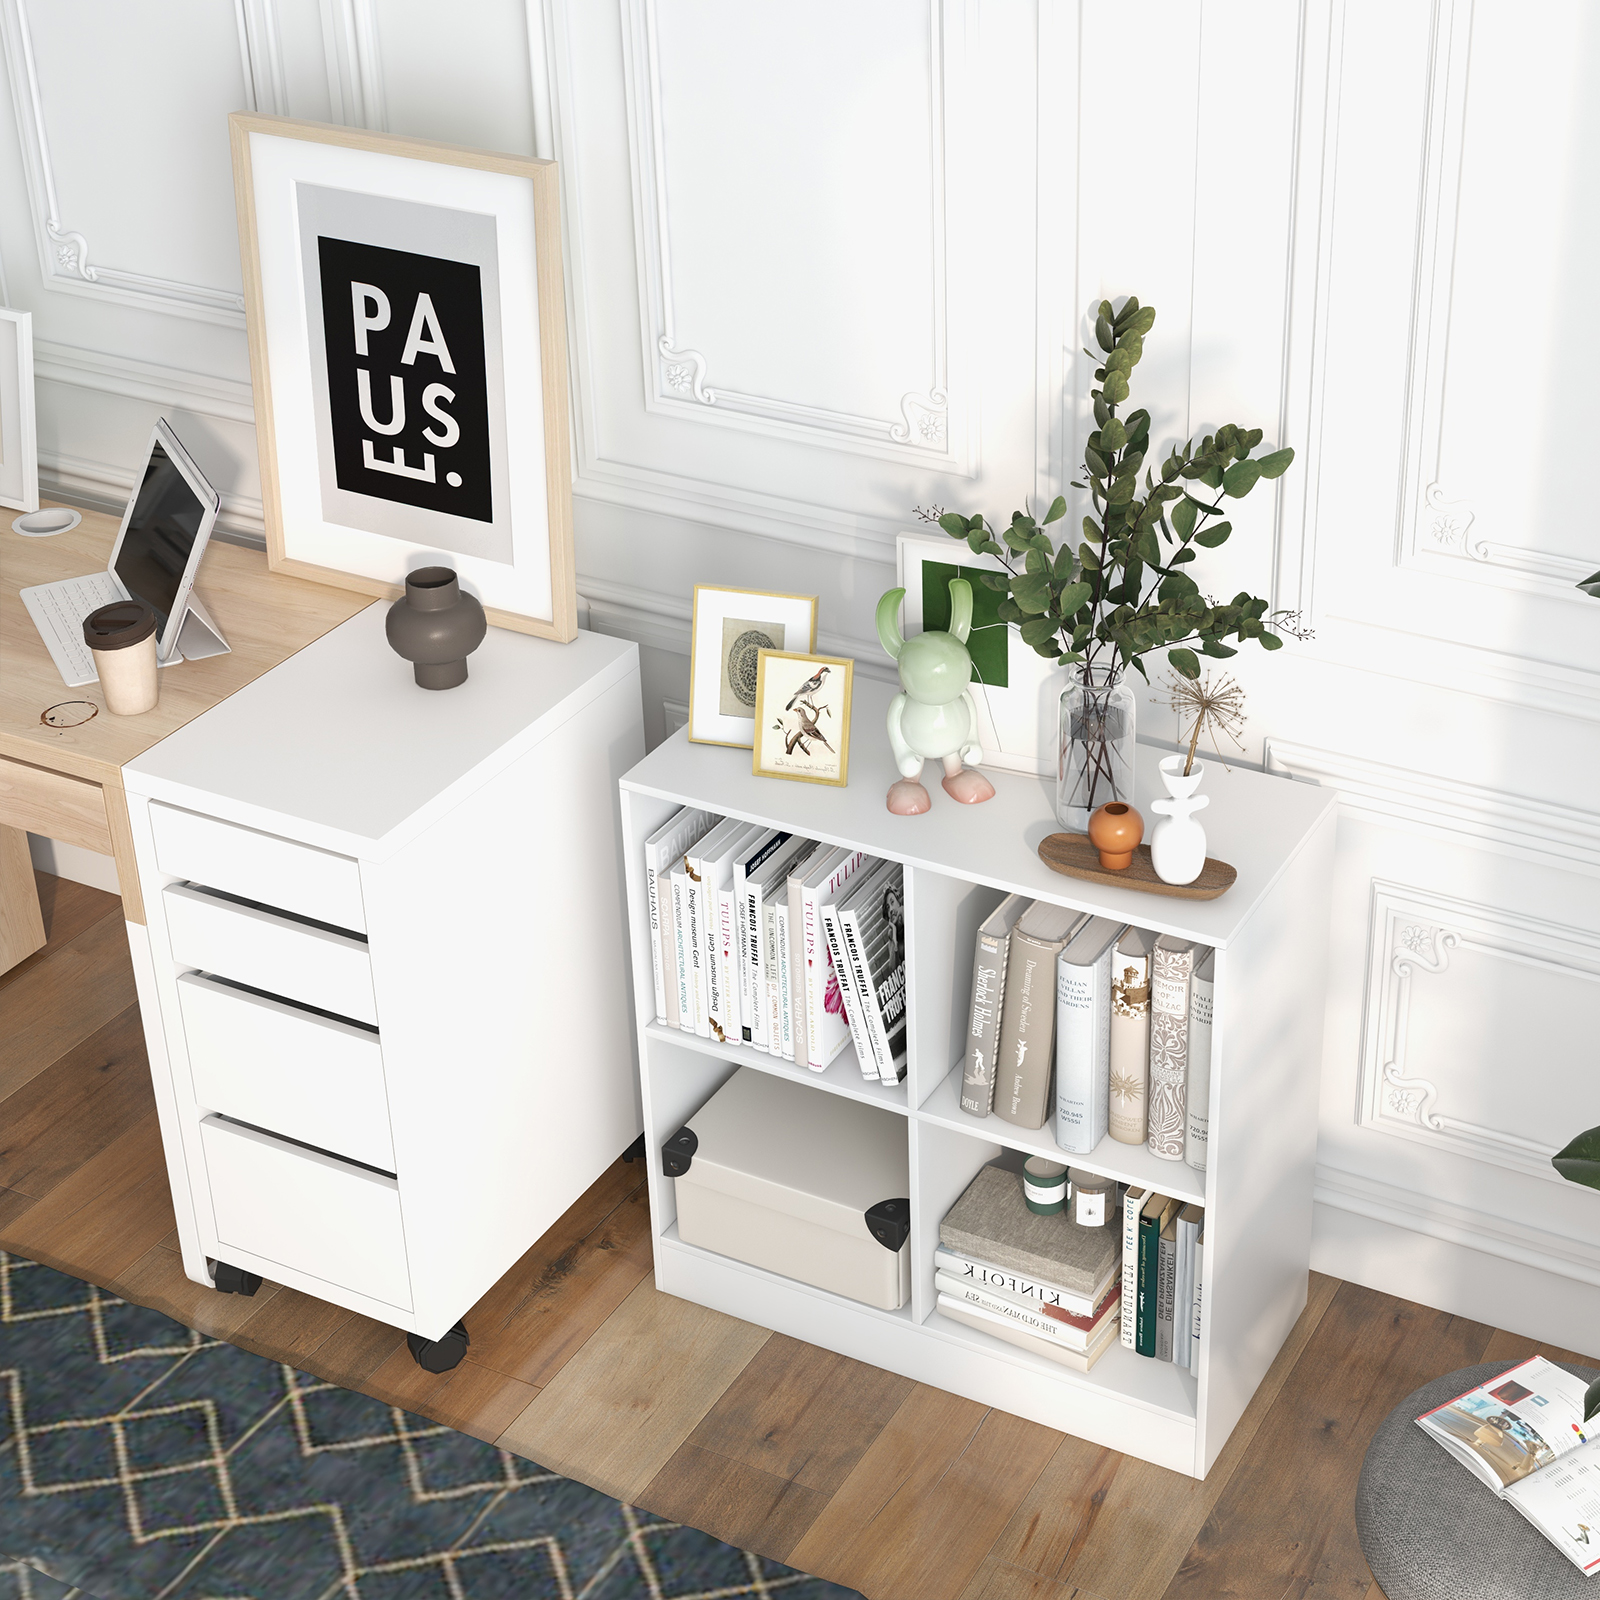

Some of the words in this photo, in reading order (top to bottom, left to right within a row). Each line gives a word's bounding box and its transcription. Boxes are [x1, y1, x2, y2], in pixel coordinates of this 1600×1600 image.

[647, 868, 659, 931] BAUHAUS
[673, 884, 683, 929] COMPENDIUM
[688, 888, 697, 915] Design
[748, 894, 758, 932] FRANCOIS
[660, 896, 670, 937] SCARPA
[690, 915, 698, 948] museum
[720, 902, 731, 947] TULIPS
[804, 901, 815, 955] TULIPS
[707, 932, 716, 952] Gent
[740, 920, 748, 959] HOFFMANN
[750, 933, 759, 966] TRUFFAT
[768, 928, 776, 960] UNCOMMON
[778, 916, 787, 959] COMPENDIUM
[844, 923, 859, 962] FRANCOIS
[676, 929, 687, 980] ARCHITECTURAL
[692, 949, 700, 968] Gent
[709, 953, 718, 985] museum
[724, 965, 730, 975] BY
[771, 984, 777, 992] OF
[780, 959, 789, 1010] ARCHITECTURAL
[808, 977, 814, 988] BY
[824, 917, 839, 955] FRANCOIS
[836, 957, 850, 992] TRUFFAT
[848, 1008, 862, 1044] Complete
[856, 1043, 866, 1059] Films
[854, 963, 869, 998] TRUFFAT
[975, 965, 997, 1005] Sherlock
[1020, 959, 1037, 996] Dreaming
[1059, 975, 1087, 987] ITALIAN
[1061, 983, 1086, 994] VILLAS
[679, 981, 688, 1014] ANTIQUES
[711, 985, 720, 1012] Design
[864, 1000, 872, 1012] The
[1021, 995, 1032, 1006] of
[1057, 996, 1090, 1009] GARDENS
[1069, 994, 1092, 1002] THEIR
[782, 1010, 790, 1042] ANTIQUES
[794, 997, 804, 1044] SCARPA
[866, 1013, 881, 1049] Complete
[971, 1004, 992, 1038] Holmes
[1018, 1004, 1031, 1034] Sweden
[876, 1049, 885, 1065] Films
[1012, 1073, 1023, 1096] Andrew
[961, 1096, 979, 1112] DOYLE
[1010, 1096, 1020, 1115] Brown
[1059, 1106, 1083, 1119] 720.945
